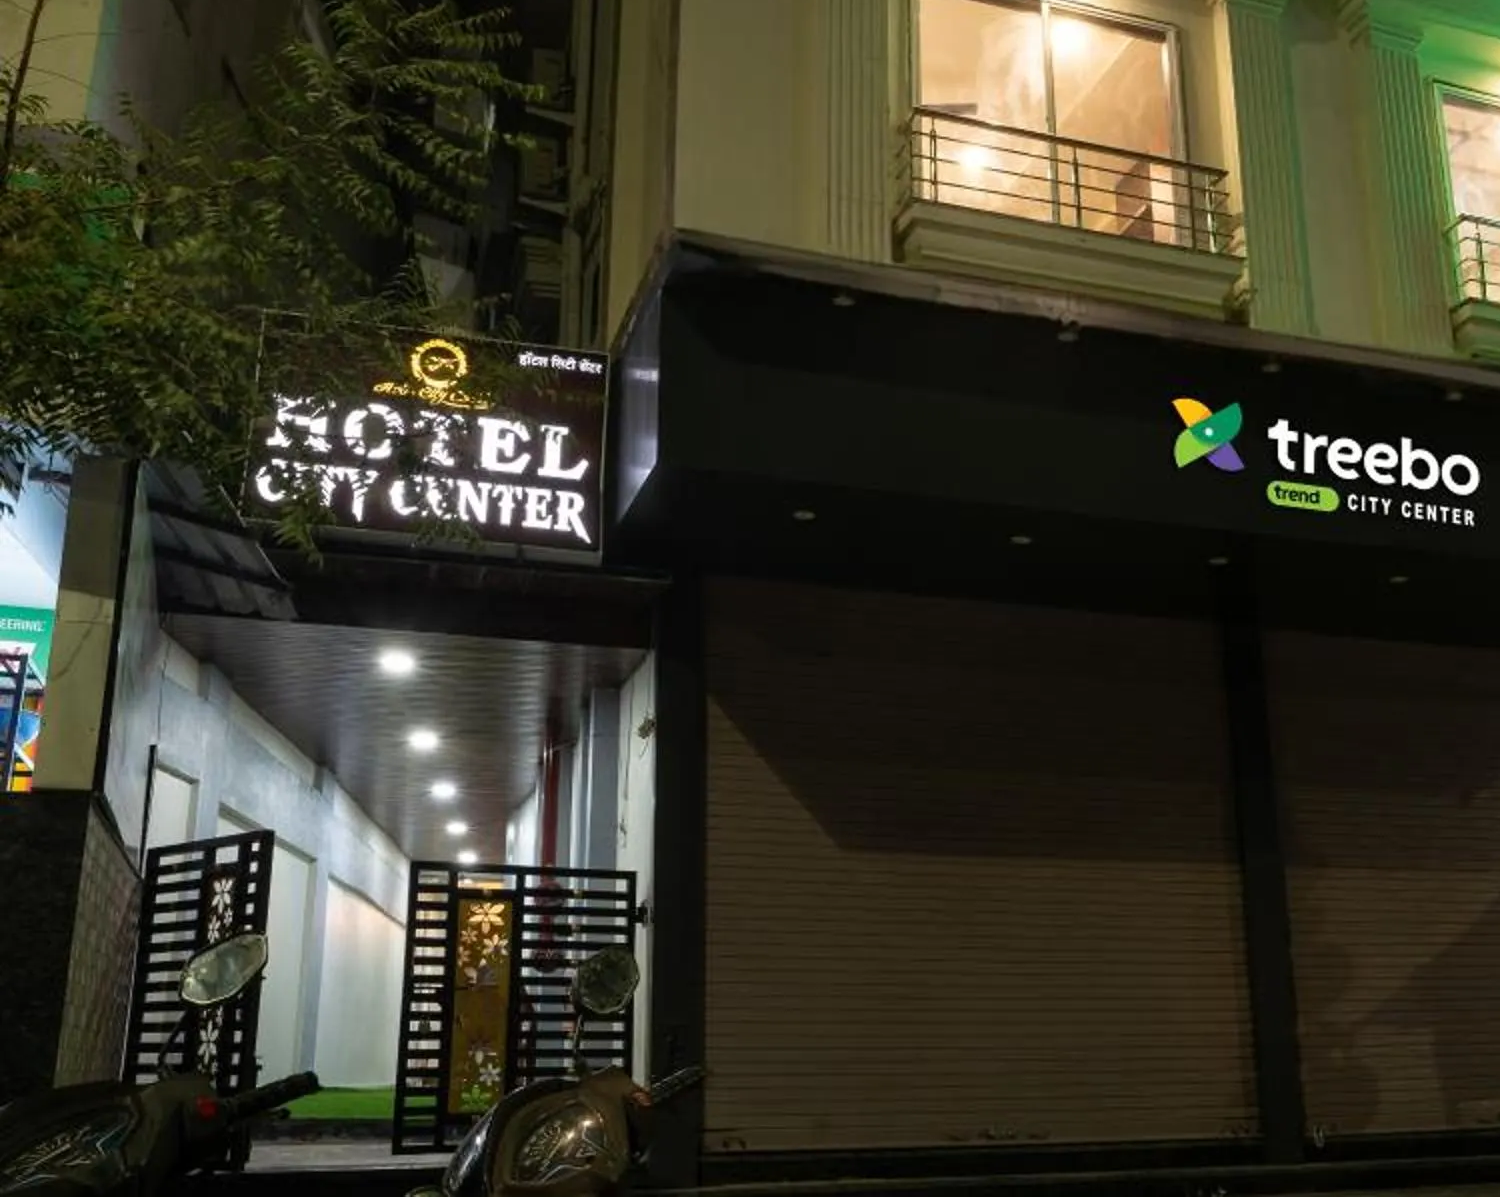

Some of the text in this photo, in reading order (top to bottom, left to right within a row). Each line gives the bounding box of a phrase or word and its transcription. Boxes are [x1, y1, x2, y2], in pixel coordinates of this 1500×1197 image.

[265, 393, 590, 481] HOTEL
[1267, 418, 1480, 496] treebo
[1274, 485, 1476, 527] trend CITY CENTER
